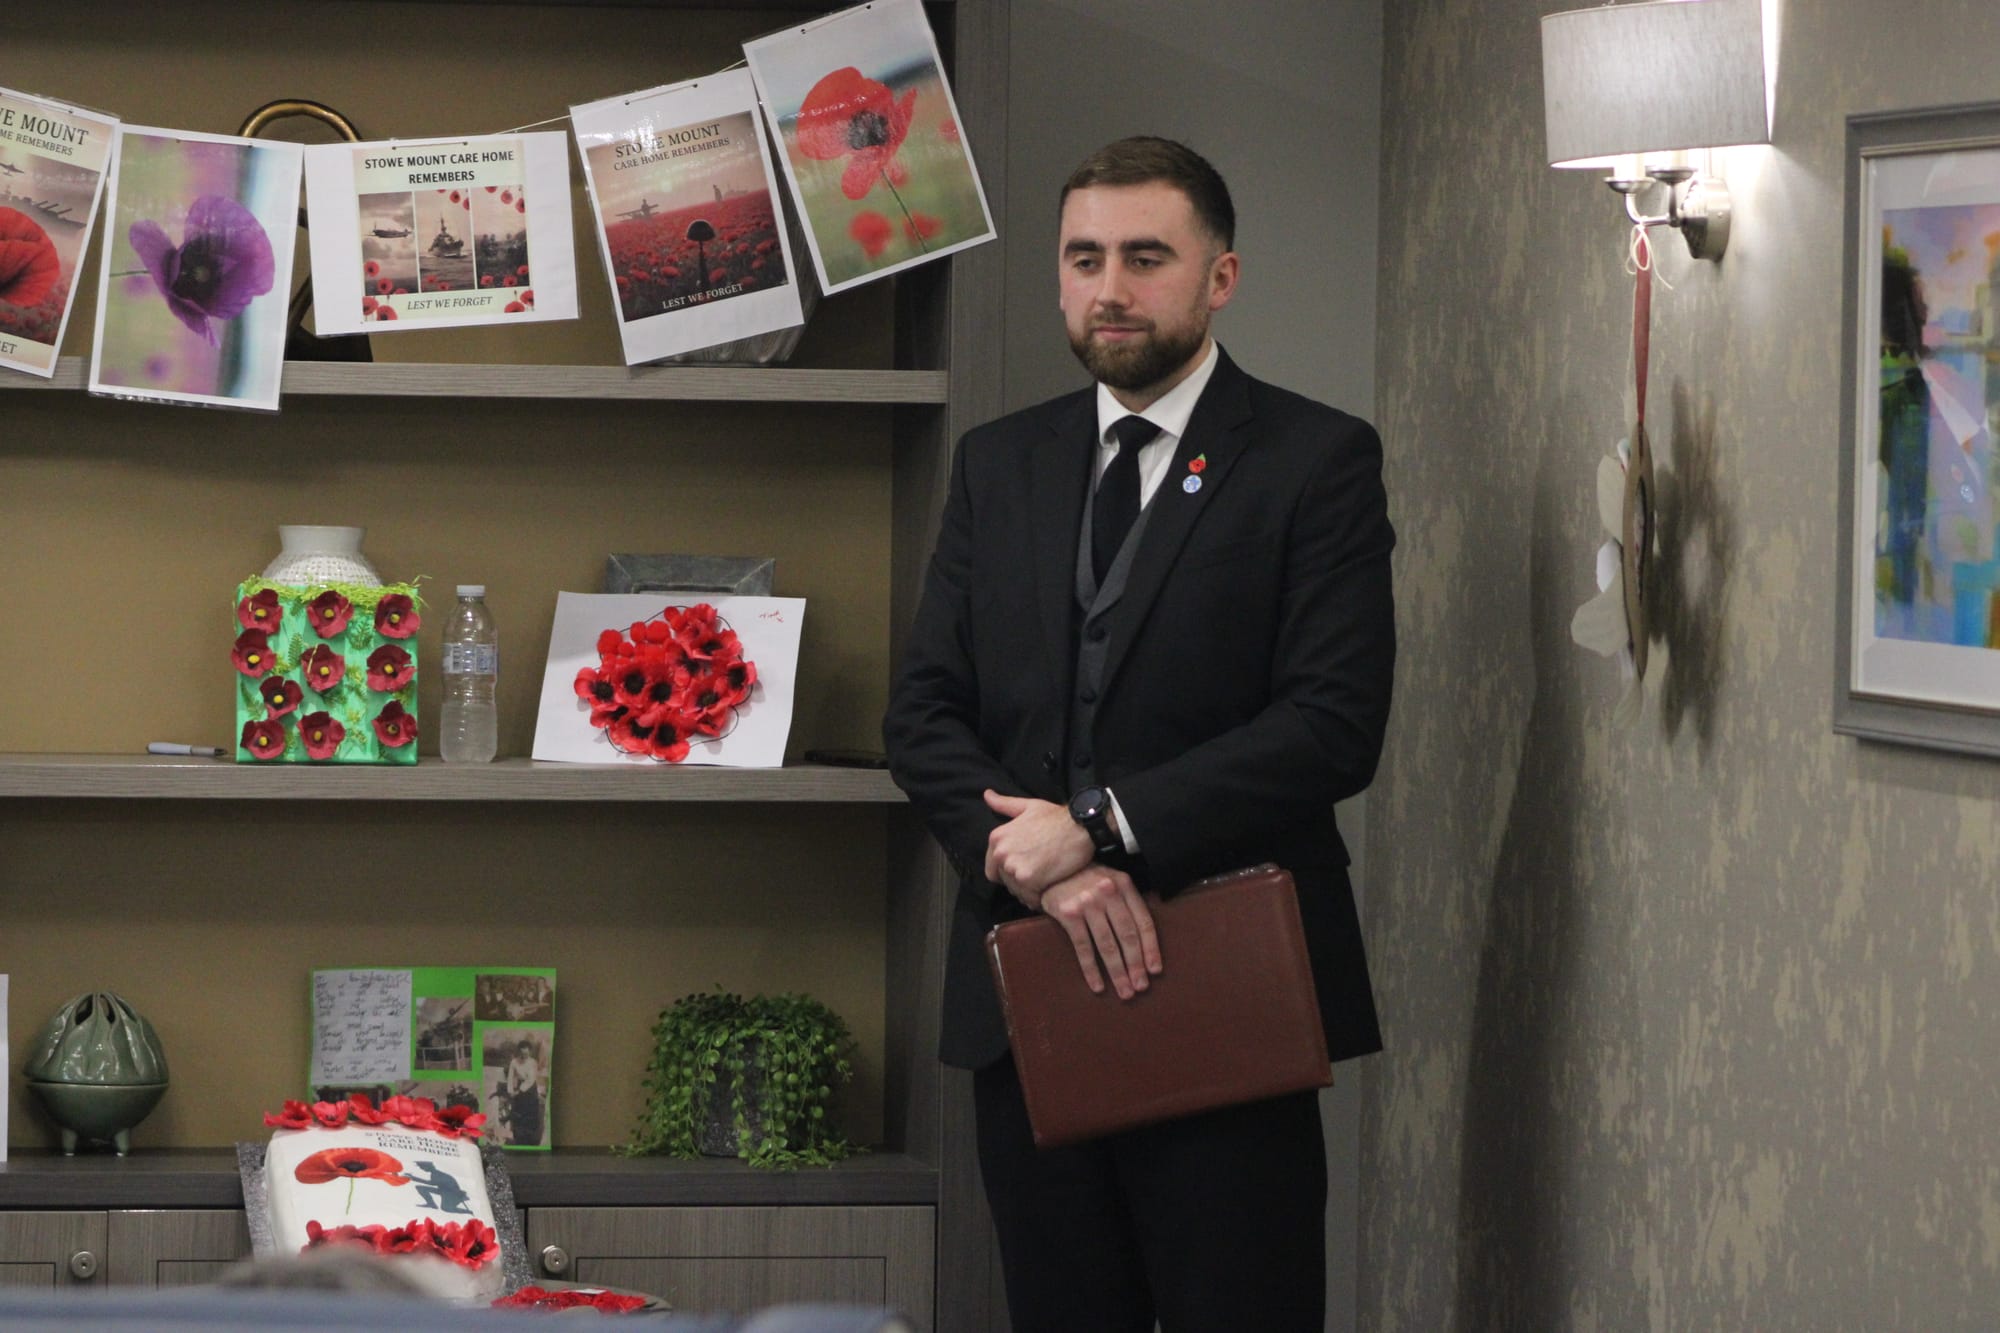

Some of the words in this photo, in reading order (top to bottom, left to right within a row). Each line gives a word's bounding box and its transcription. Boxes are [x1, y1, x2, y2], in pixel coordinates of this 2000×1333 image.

[0, 107, 16, 127] E
[20, 113, 89, 146] MOUNT
[16, 133, 74, 156] REMEMBERS
[615, 136, 665, 158] STOE
[668, 123, 721, 146] MOUNT
[364, 157, 404, 169] STOWE
[407, 154, 447, 167] MOUNT
[450, 152, 479, 165] CARE
[482, 150, 515, 163] HOME
[613, 158, 639, 171] CARE
[640, 150, 670, 165] HOME
[671, 137, 731, 159] REMEMBERS
[408, 170, 476, 184] REMEMBERS
[407, 300, 433, 310] LEST
[434, 298, 451, 308] WE
[452, 296, 493, 307] FORGET
[662, 296, 686, 309] LEST
[687, 291, 704, 303] WE
[706, 283, 744, 299] FORGET
[0, 341, 18, 354] ET
